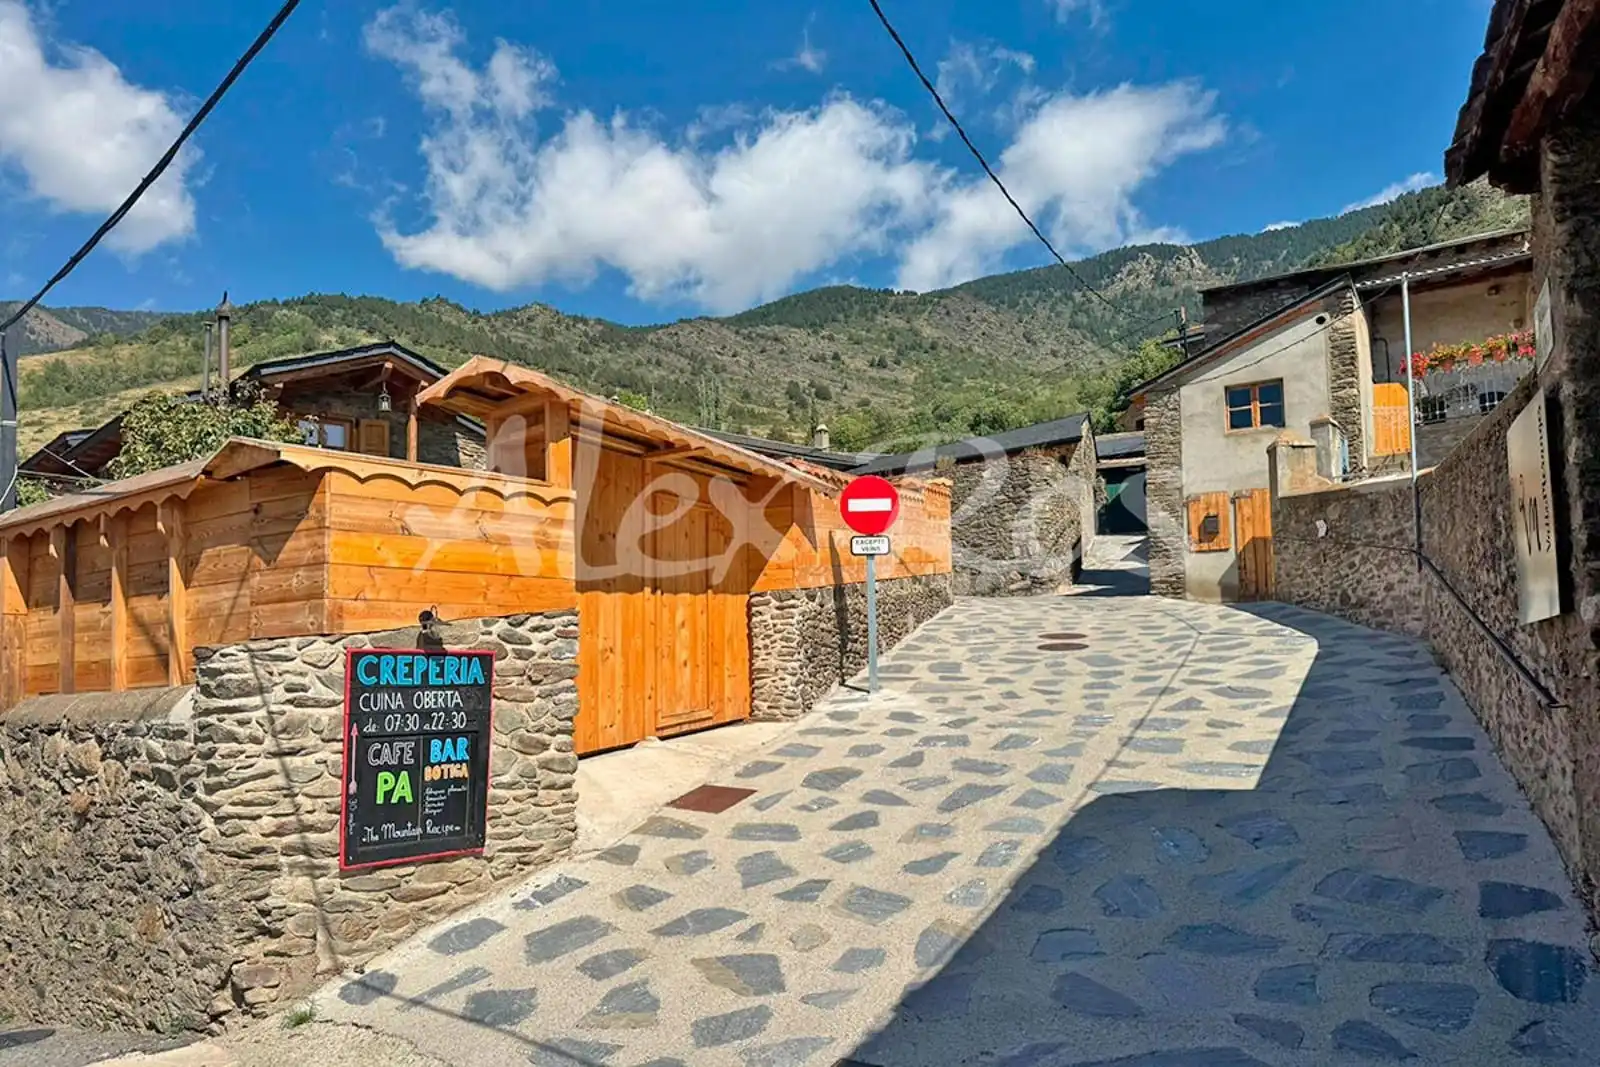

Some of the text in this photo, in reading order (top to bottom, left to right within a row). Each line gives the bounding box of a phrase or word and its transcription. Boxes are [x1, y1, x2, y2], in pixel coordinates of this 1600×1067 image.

[356, 655, 485, 686] CREPERIA
[359, 691, 463, 711] CUINA OBERTA
[363, 718, 378, 733] de
[384, 713, 419, 732] 07:30
[367, 742, 415, 766] CAFE
[430, 737, 469, 763] BAR
[376, 770, 413, 805] PA
[364, 826, 379, 843] The
[426, 818, 455, 836] Recipe
